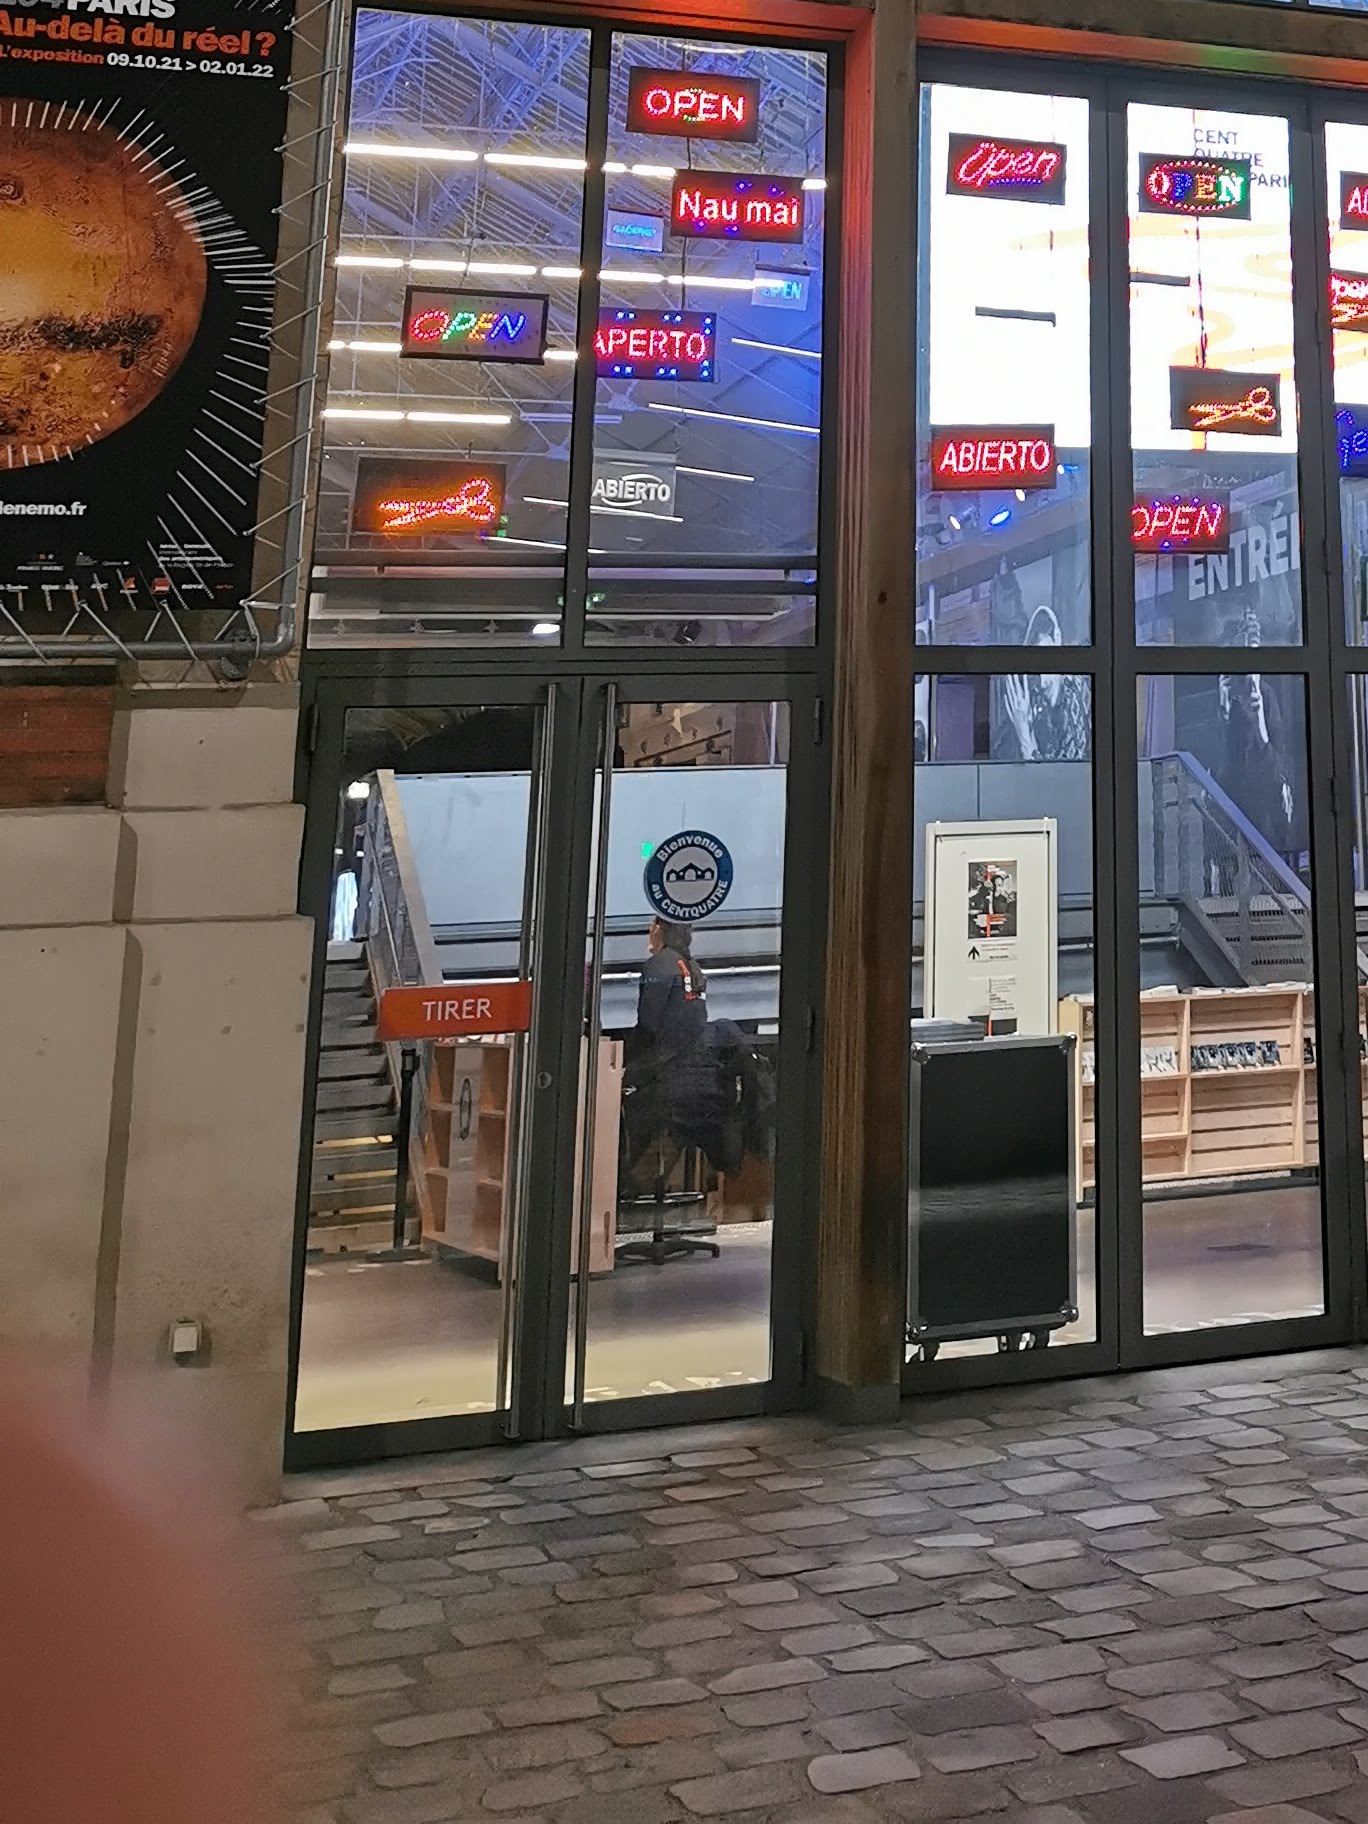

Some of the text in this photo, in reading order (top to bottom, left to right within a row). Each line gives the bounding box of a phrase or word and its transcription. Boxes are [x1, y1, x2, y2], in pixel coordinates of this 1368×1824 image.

[0, 8, 125, 45] Au-delà
[131, 21, 176, 49] du
[188, 26, 250, 55] réel
[106, 51, 183, 72] 09.10.21
[199, 60, 274, 78] 02.01.22
[645, 87, 745, 124] OPEN
[1194, 128, 1239, 146] CENT
[957, 140, 1060, 188] Open
[1249, 172, 1290, 188] PARI
[1147, 170, 1246, 202] OPEN
[678, 189, 798, 226] Nau mai
[410, 308, 527, 343] OPEN
[593, 328, 707, 360] APERTO
[939, 438, 1051, 473] ABIERTO
[591, 477, 672, 500] ABIERTO
[1130, 504, 1224, 539] OPEN
[656, 833, 724, 863] Bienvenue
[651, 879, 729, 918] au CENTQUATRE
[422, 997, 493, 1021] TIRER
